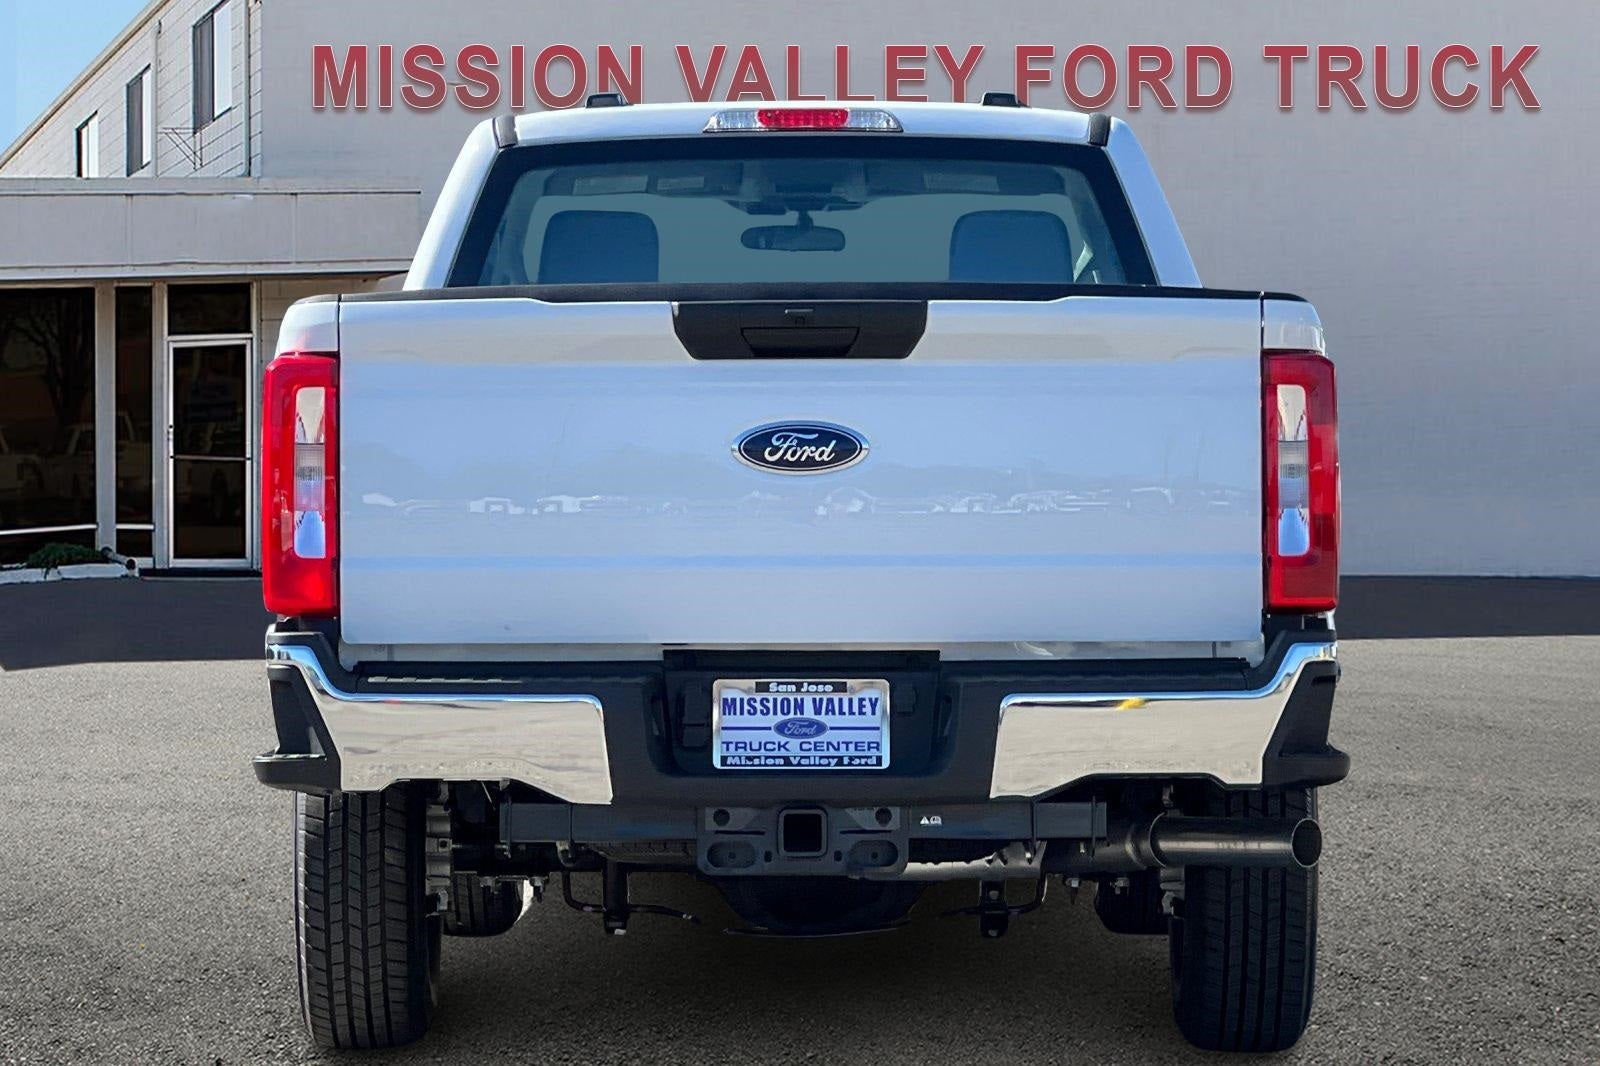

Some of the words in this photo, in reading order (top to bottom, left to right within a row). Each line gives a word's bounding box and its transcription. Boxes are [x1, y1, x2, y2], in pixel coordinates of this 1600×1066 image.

[312, 44, 644, 109] MISSION
[676, 44, 985, 102] VALLEY
[1014, 44, 1234, 109] FORD
[1262, 44, 1541, 109] TRUCK
[764, 431, 837, 462] Ford
[769, 682, 797, 692] San
[722, 698, 805, 716] MISSION
[812, 698, 880, 716] VALLEY
[784, 721, 817, 735] Ford
[722, 741, 791, 752] TRUCK
[800, 741, 880, 752] CENTER
[789, 756, 838, 767] Valley
